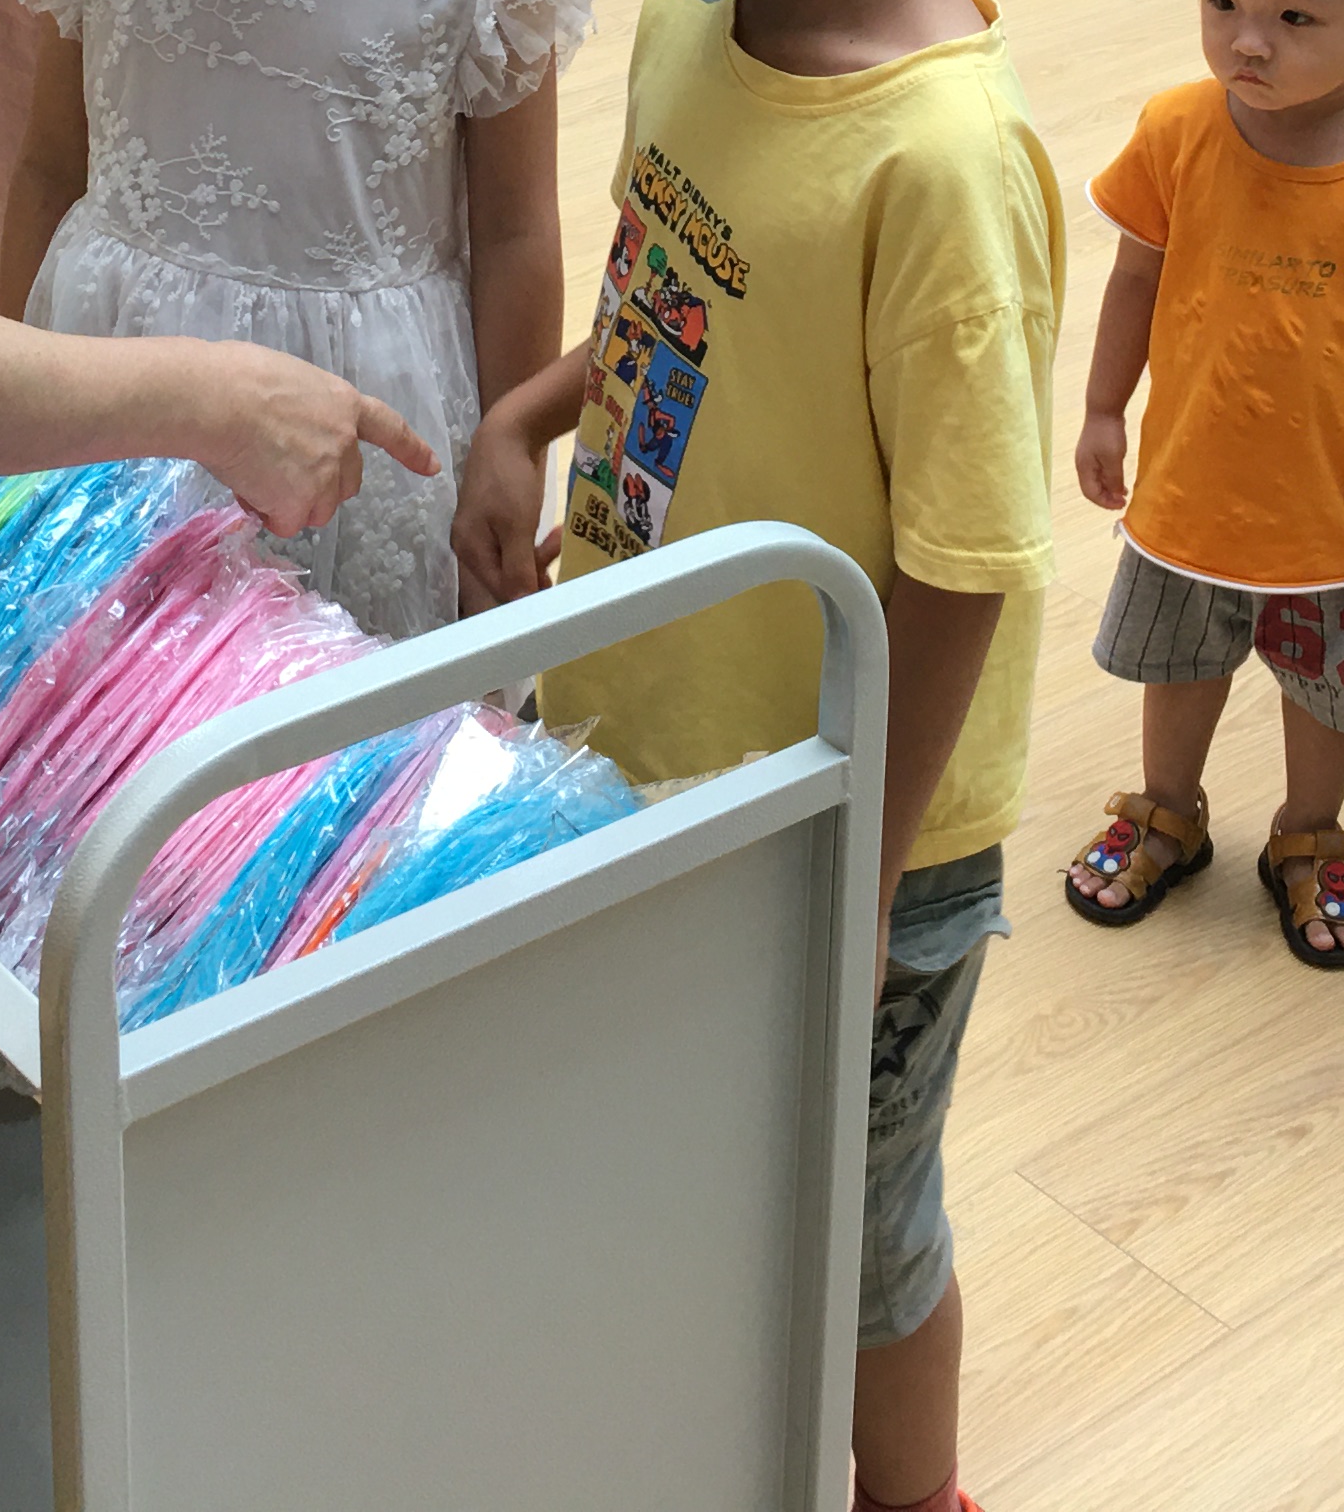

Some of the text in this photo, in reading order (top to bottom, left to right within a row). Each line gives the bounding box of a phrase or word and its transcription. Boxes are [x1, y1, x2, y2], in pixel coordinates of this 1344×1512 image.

[648, 142, 682, 181] WALT
[630, 147, 751, 300] MICKEY MOUSE
[1306, 259, 1337, 279] TO
[669, 367, 697, 389] STAY
[666, 383, 696, 409] TRUE!
[585, 494, 610, 526] BE
[570, 511, 618, 559] BEST
